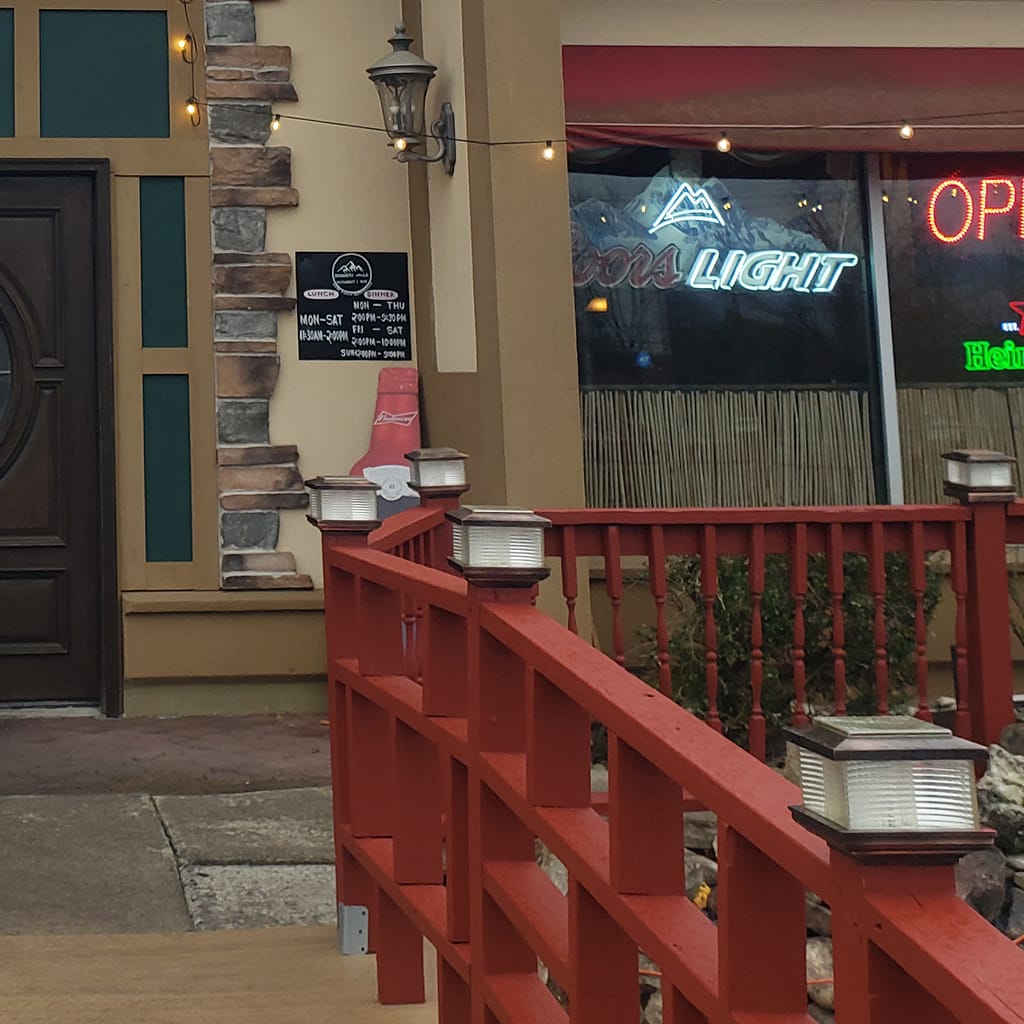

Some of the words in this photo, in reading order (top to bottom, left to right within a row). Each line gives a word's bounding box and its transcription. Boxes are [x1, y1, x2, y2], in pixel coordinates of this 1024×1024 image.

[927, 179, 1024, 242] OP
[570, 243, 682, 290] oors
[687, 248, 859, 293] LIGHT
[386, 300, 406, 311] THU
[386, 325, 404, 336] SAT
